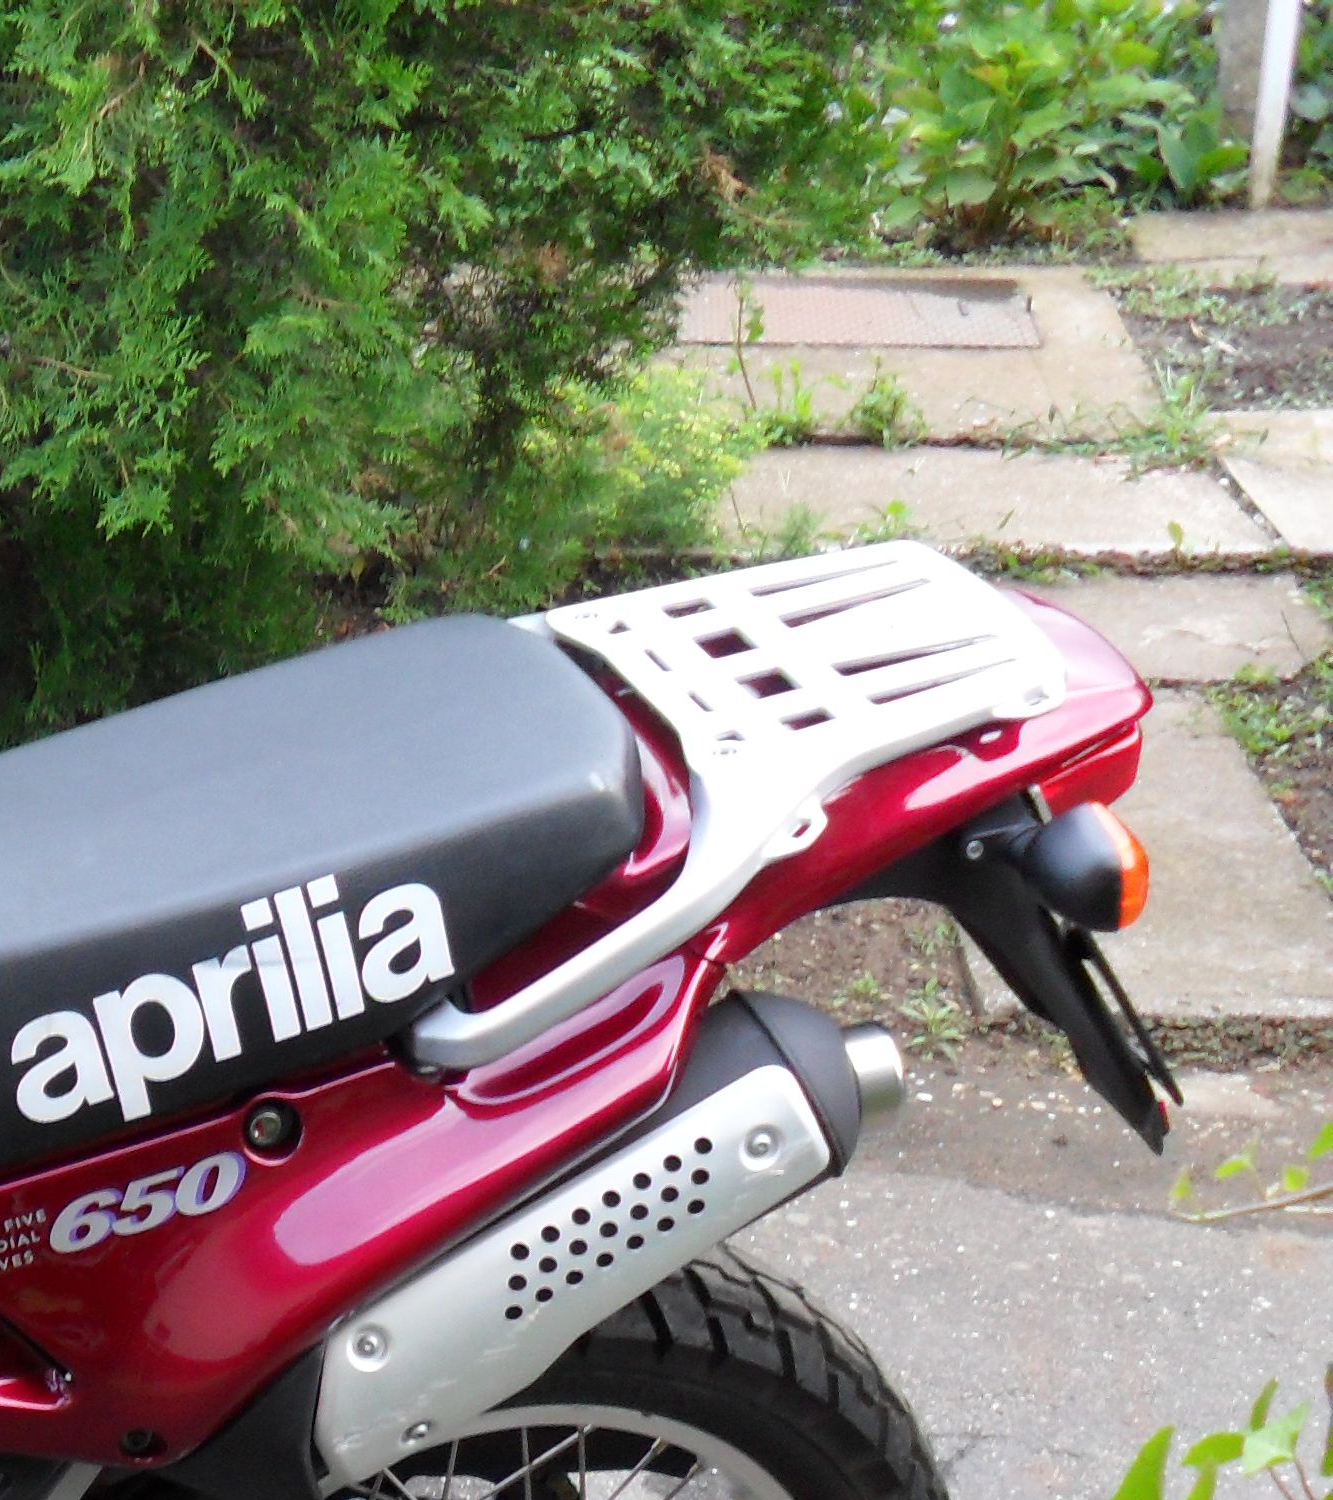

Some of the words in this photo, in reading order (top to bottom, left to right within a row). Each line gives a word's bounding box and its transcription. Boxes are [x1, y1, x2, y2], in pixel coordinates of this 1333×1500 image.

[10, 873, 456, 1124] aprilia
[3, 1208, 48, 1233] FIVE
[49, 1150, 246, 1254] 650
